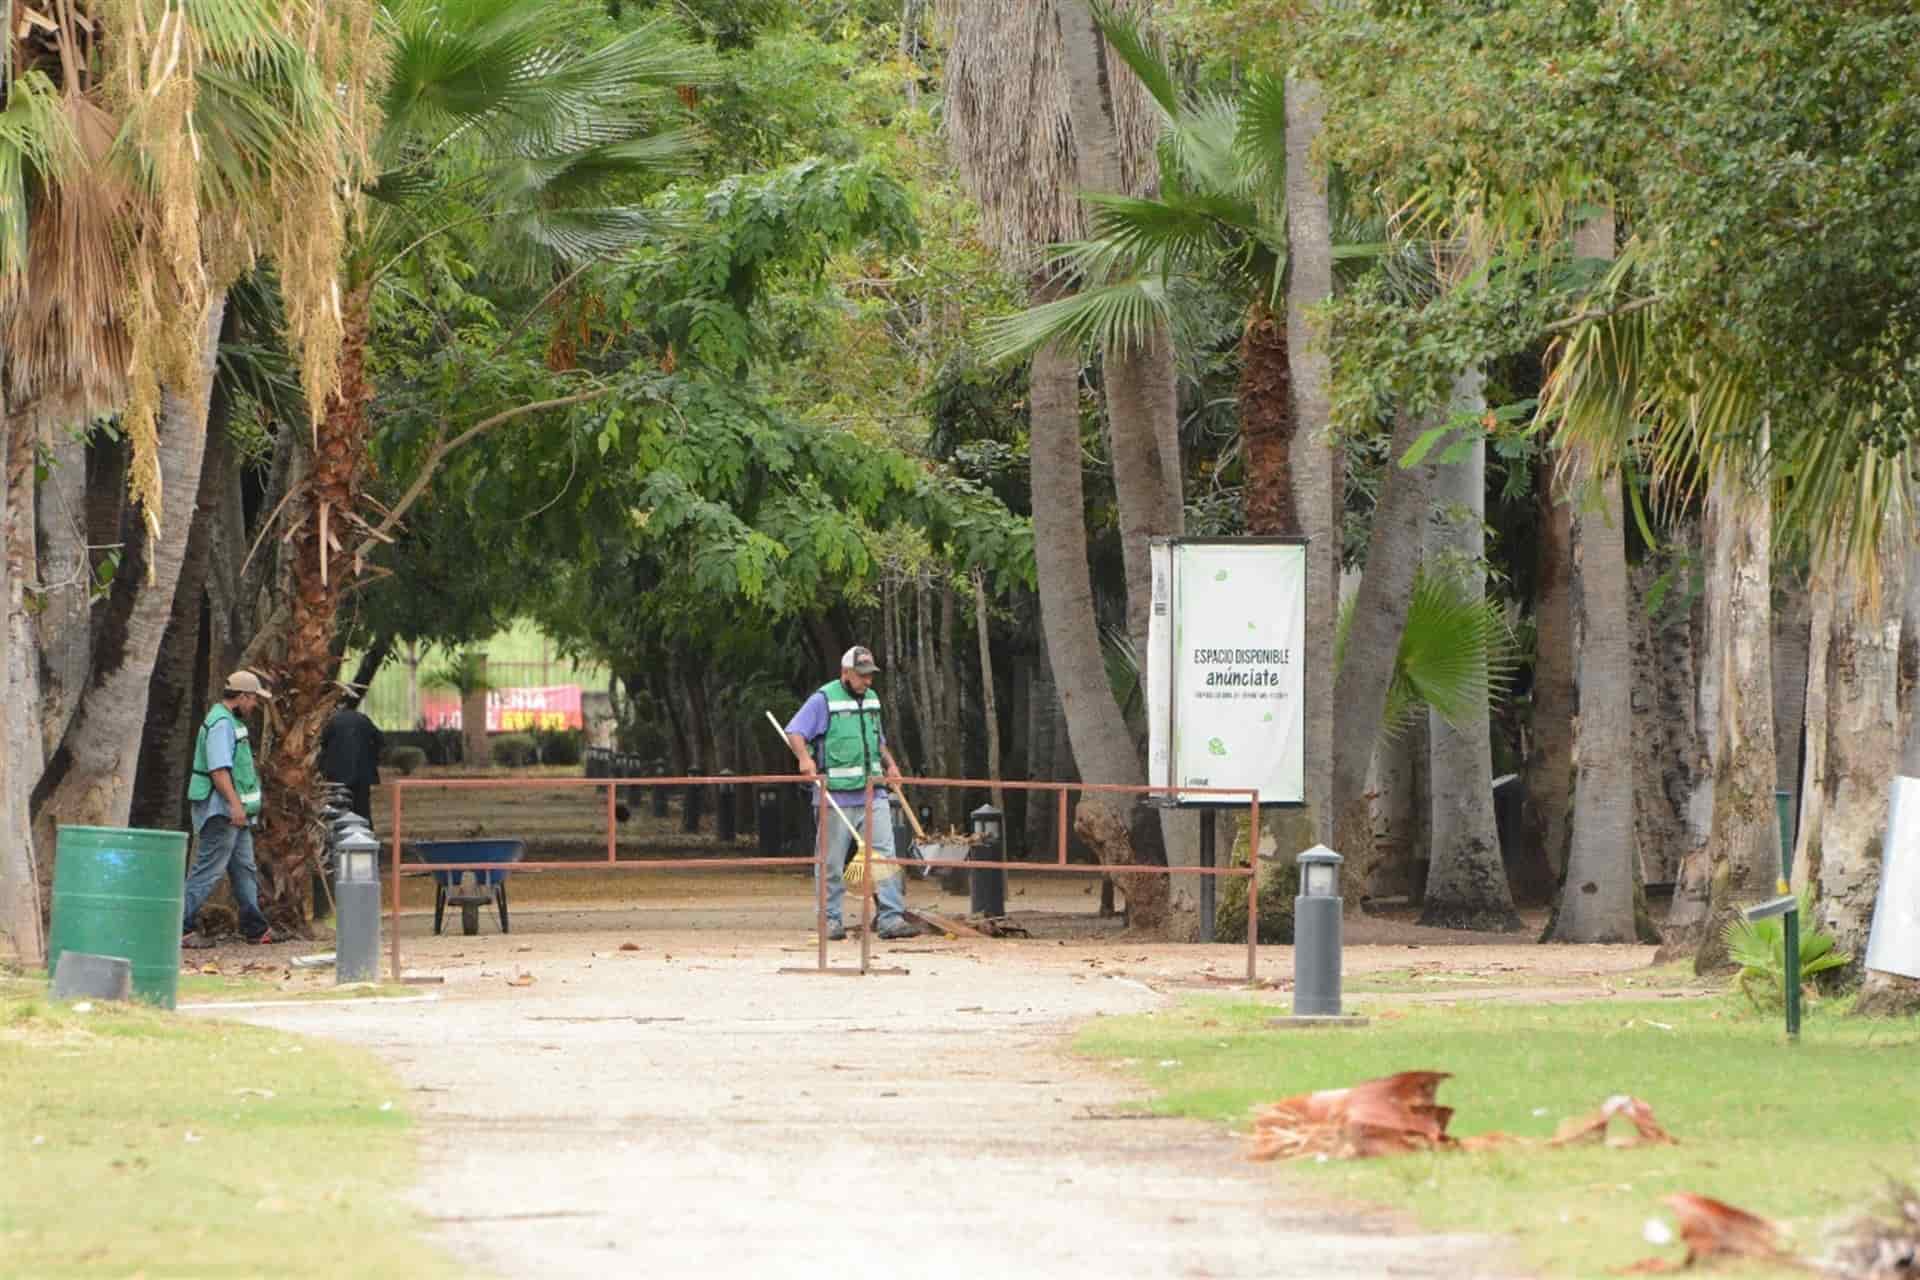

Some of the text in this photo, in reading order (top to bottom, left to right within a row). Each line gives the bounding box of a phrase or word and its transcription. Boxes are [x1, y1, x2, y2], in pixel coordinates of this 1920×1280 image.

[1193, 648, 1290, 665] ESPACIO DISPONIBLE
[1206, 665, 1280, 687] anúnciate
